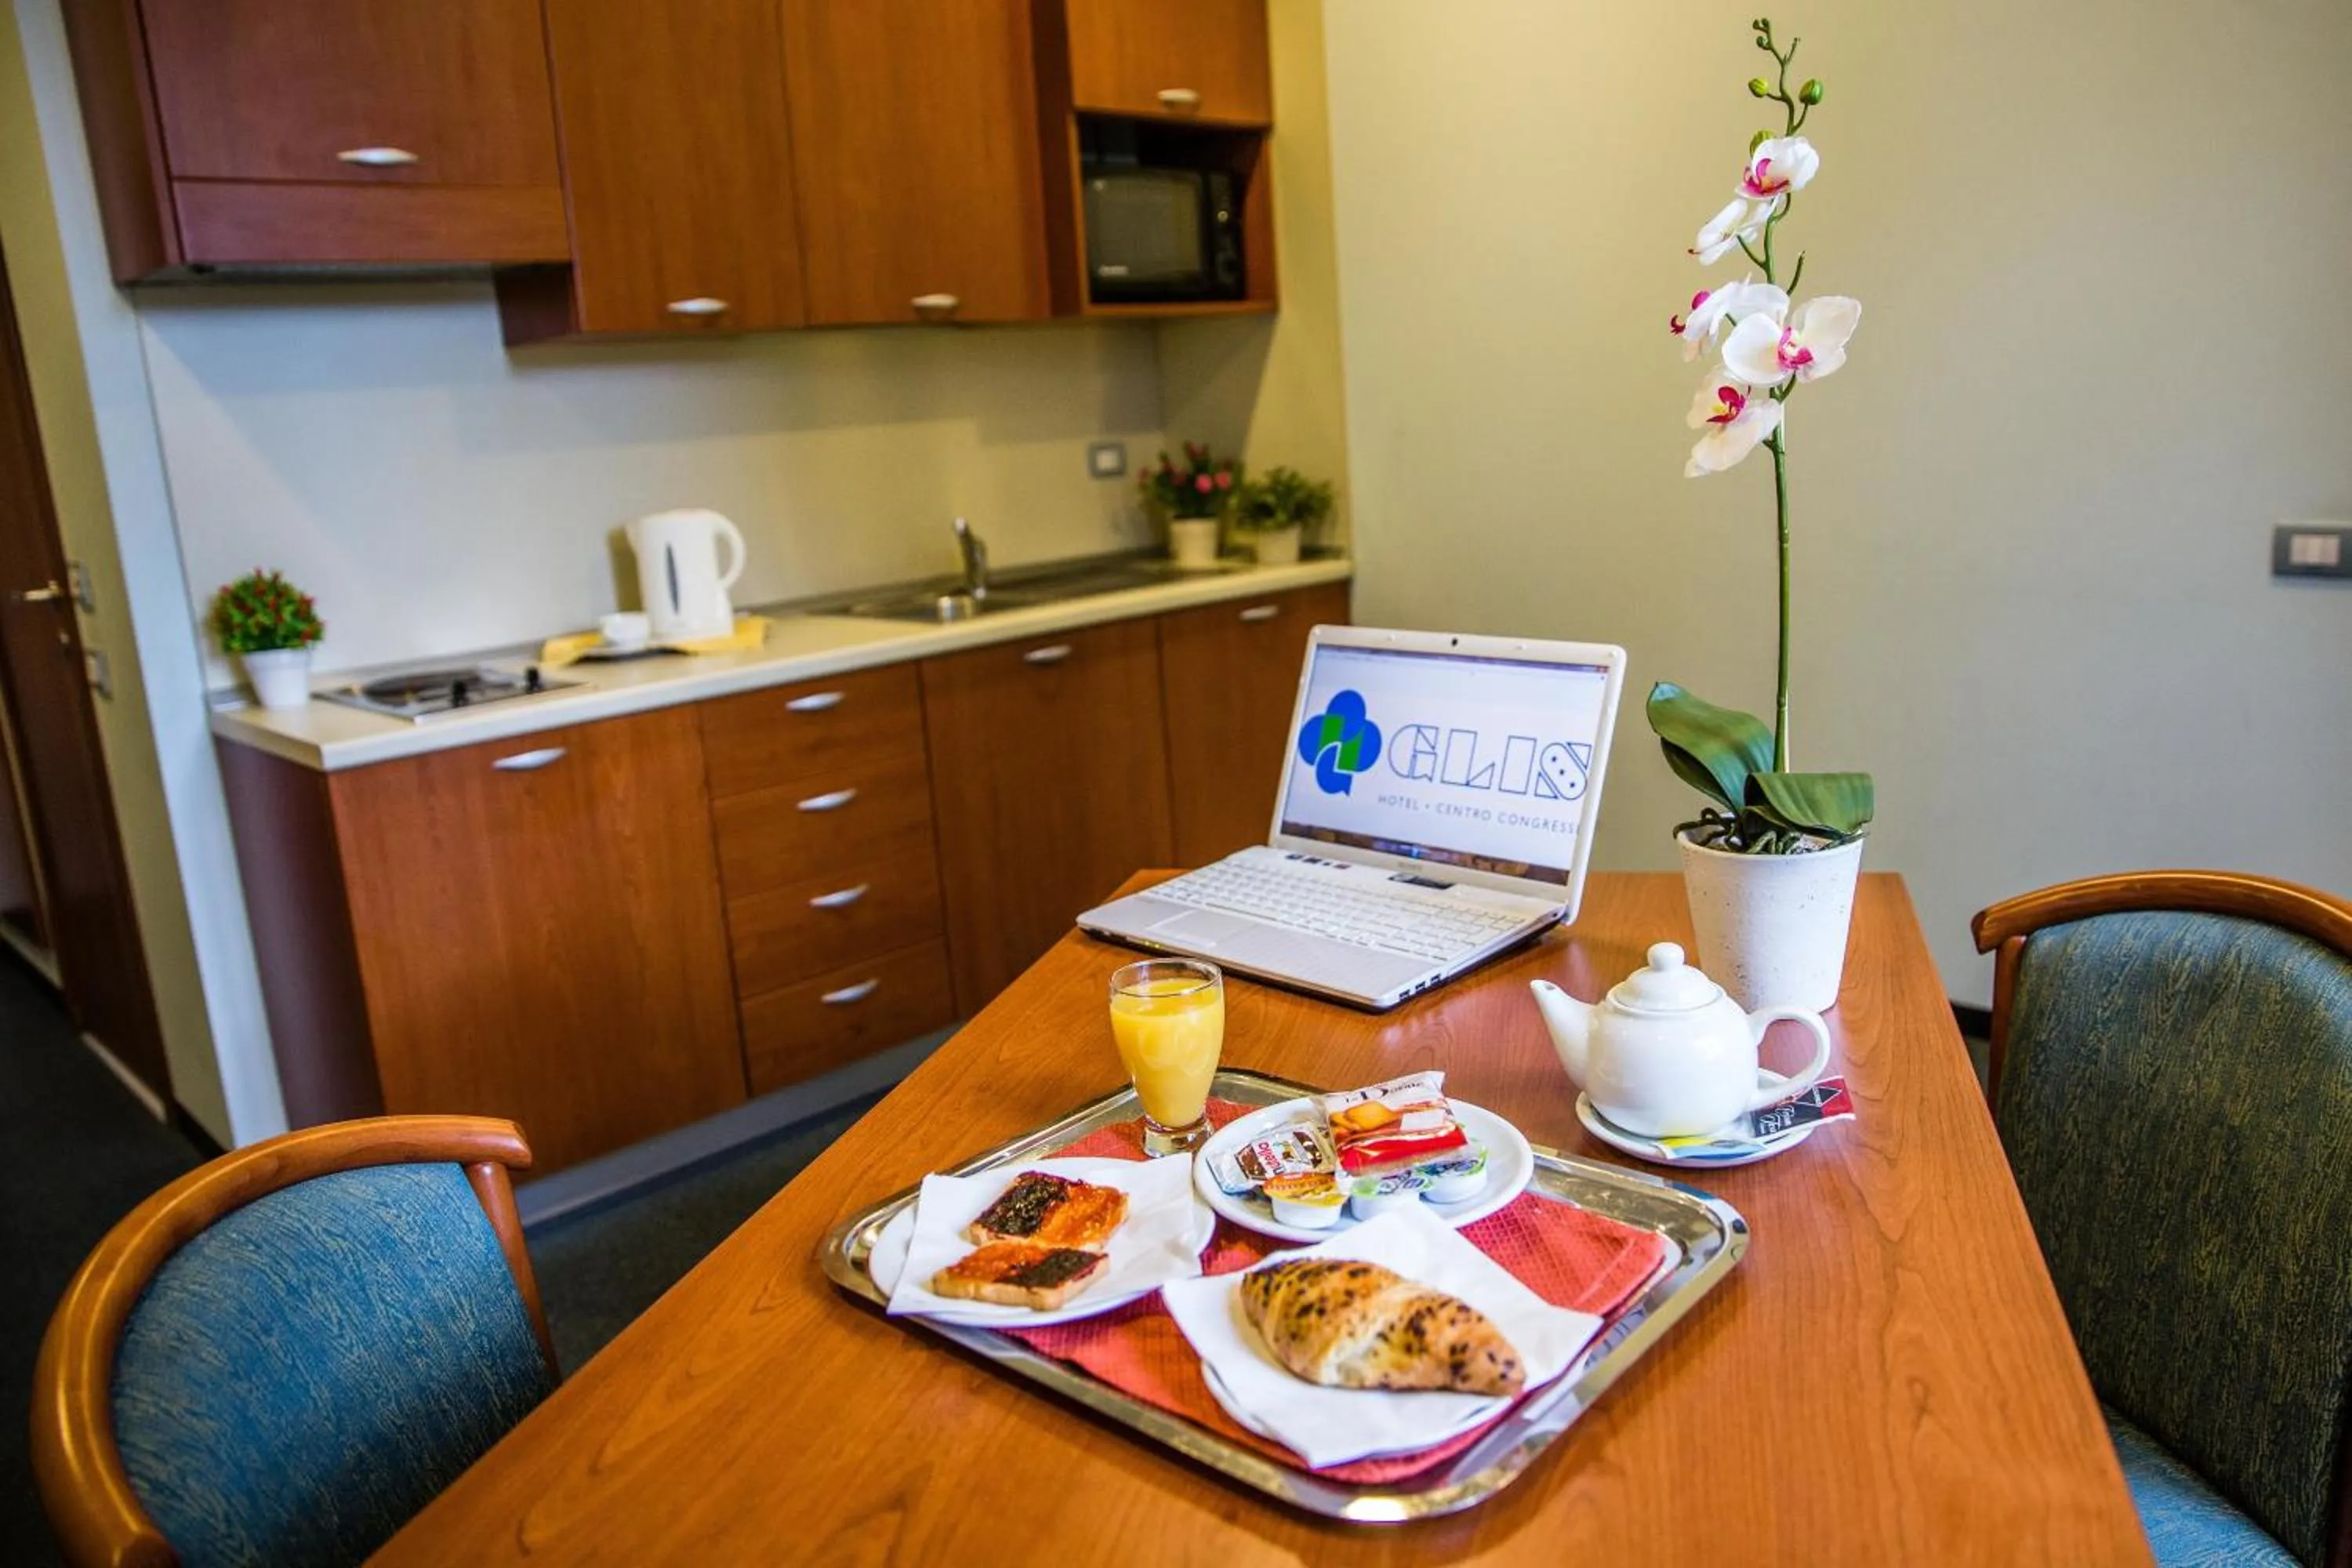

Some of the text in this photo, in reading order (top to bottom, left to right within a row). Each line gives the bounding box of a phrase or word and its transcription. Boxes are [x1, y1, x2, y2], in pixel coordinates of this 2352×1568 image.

[1377, 793, 1419, 811] HOTEL
[1436, 802, 1491, 822] CENTRO
[1256, 1141, 1287, 1174] nutella
